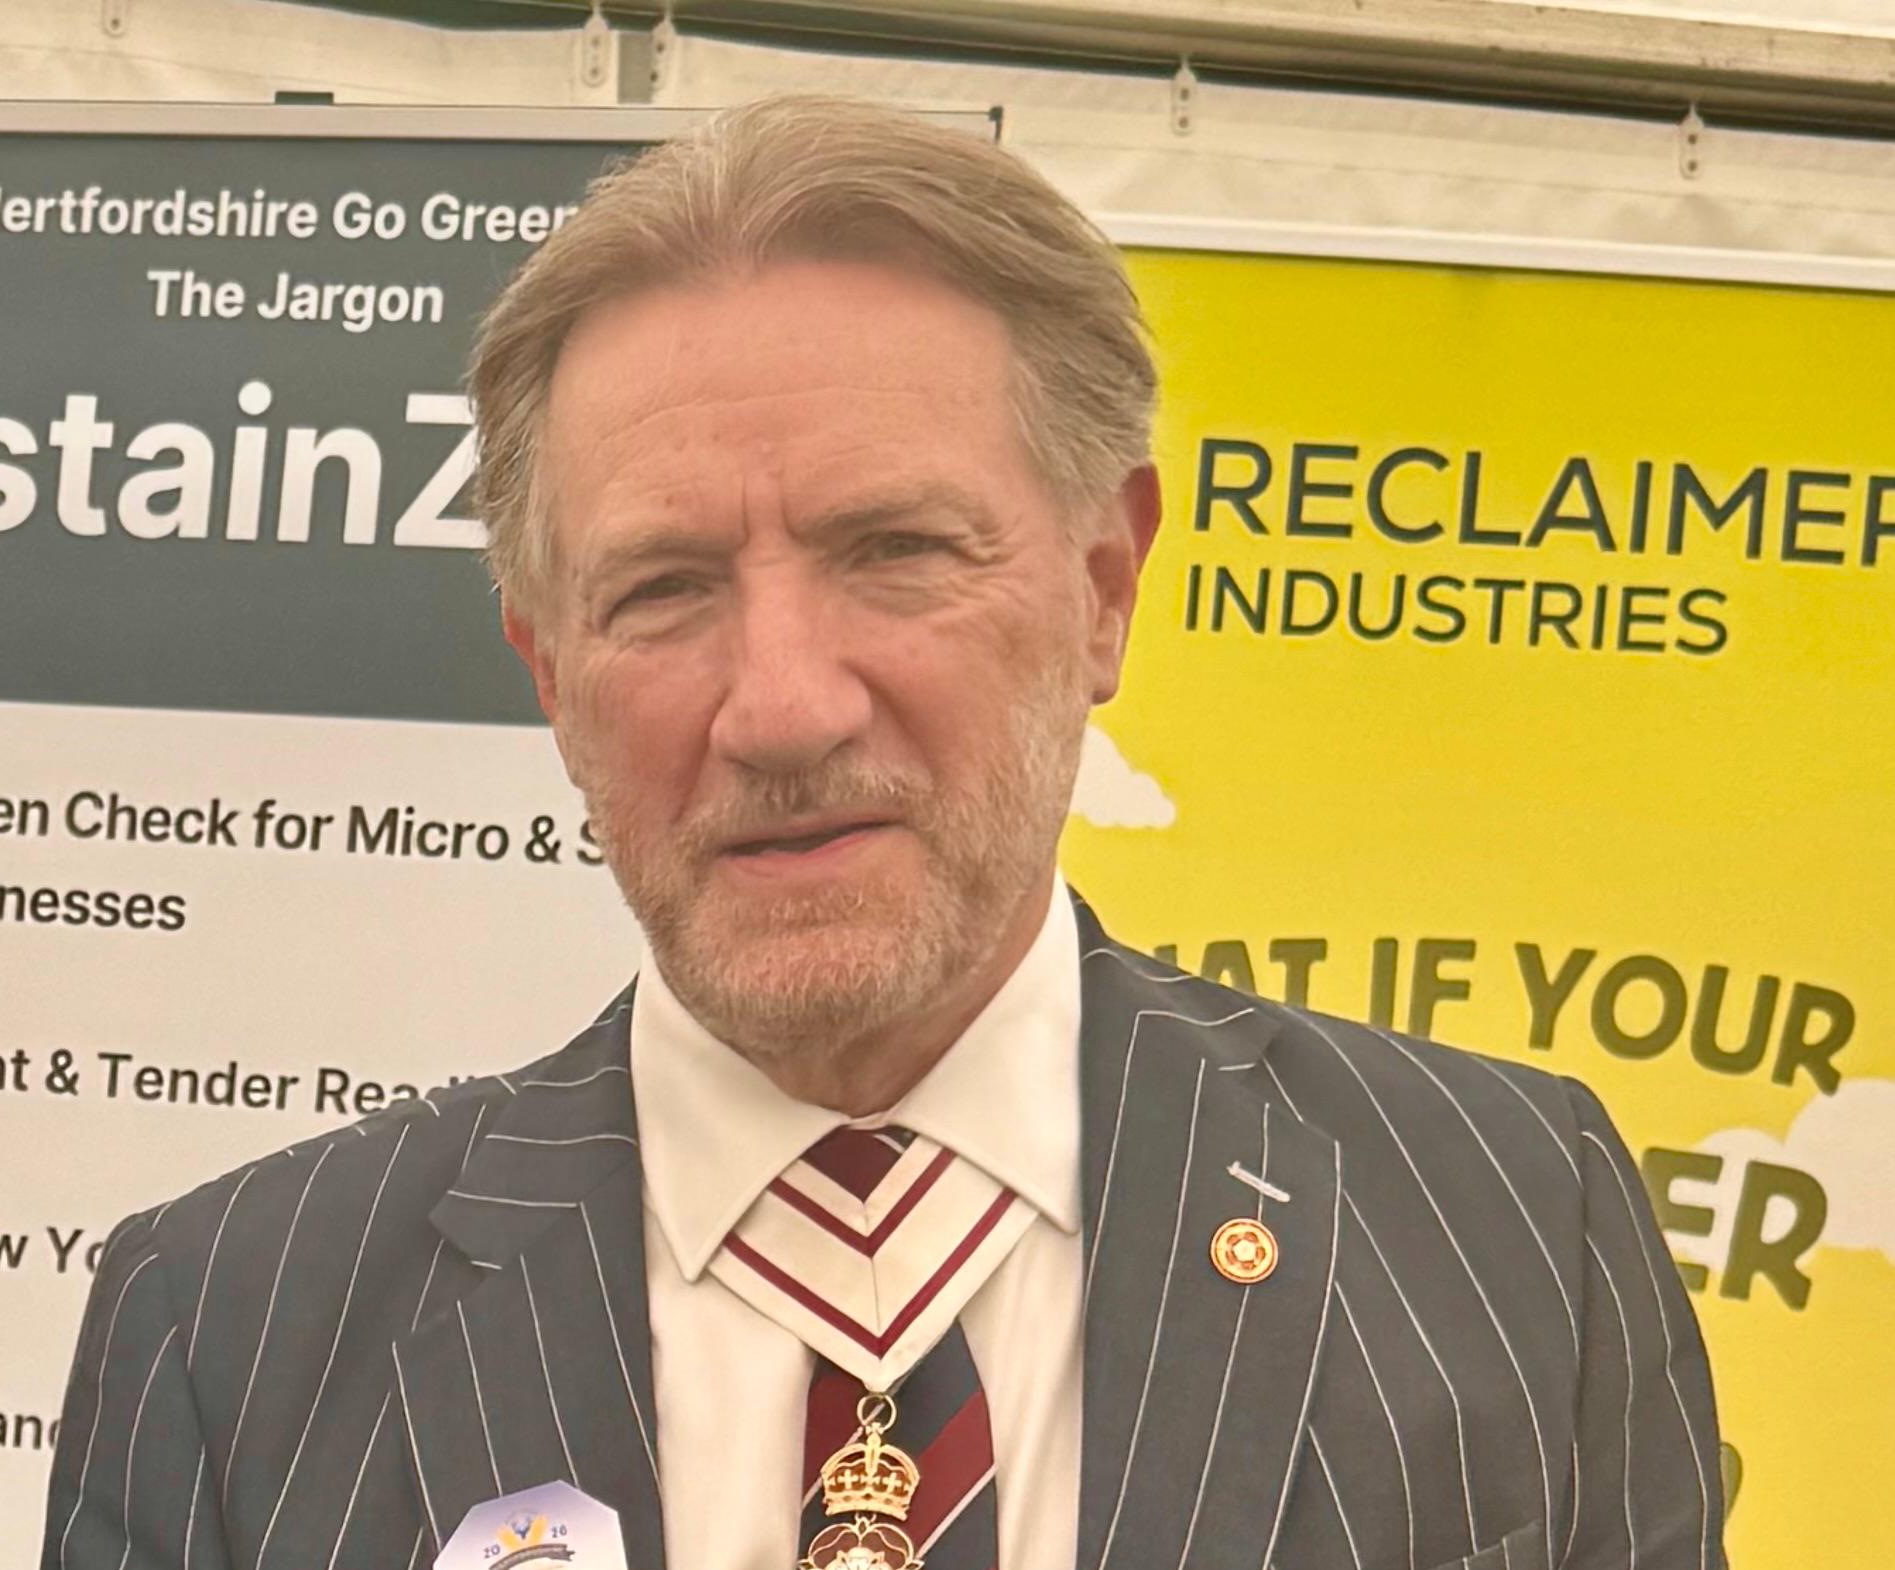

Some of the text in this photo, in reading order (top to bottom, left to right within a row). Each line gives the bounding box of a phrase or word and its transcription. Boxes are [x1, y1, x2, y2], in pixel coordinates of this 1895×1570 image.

[333, 192, 405, 239] Go
[147, 271, 443, 332] The Jargon
[1187, 565, 1727, 654] INDUSTRIES
[66, 791, 239, 846] Check
[253, 799, 334, 850] for
[347, 806, 509, 860] Micro
[525, 816, 561, 863] &
[1369, 937, 1476, 1040] IF
[1514, 941, 1856, 1093] YOUR
[46, 1049, 79, 1095] &
[98, 1052, 299, 1109] Tender
